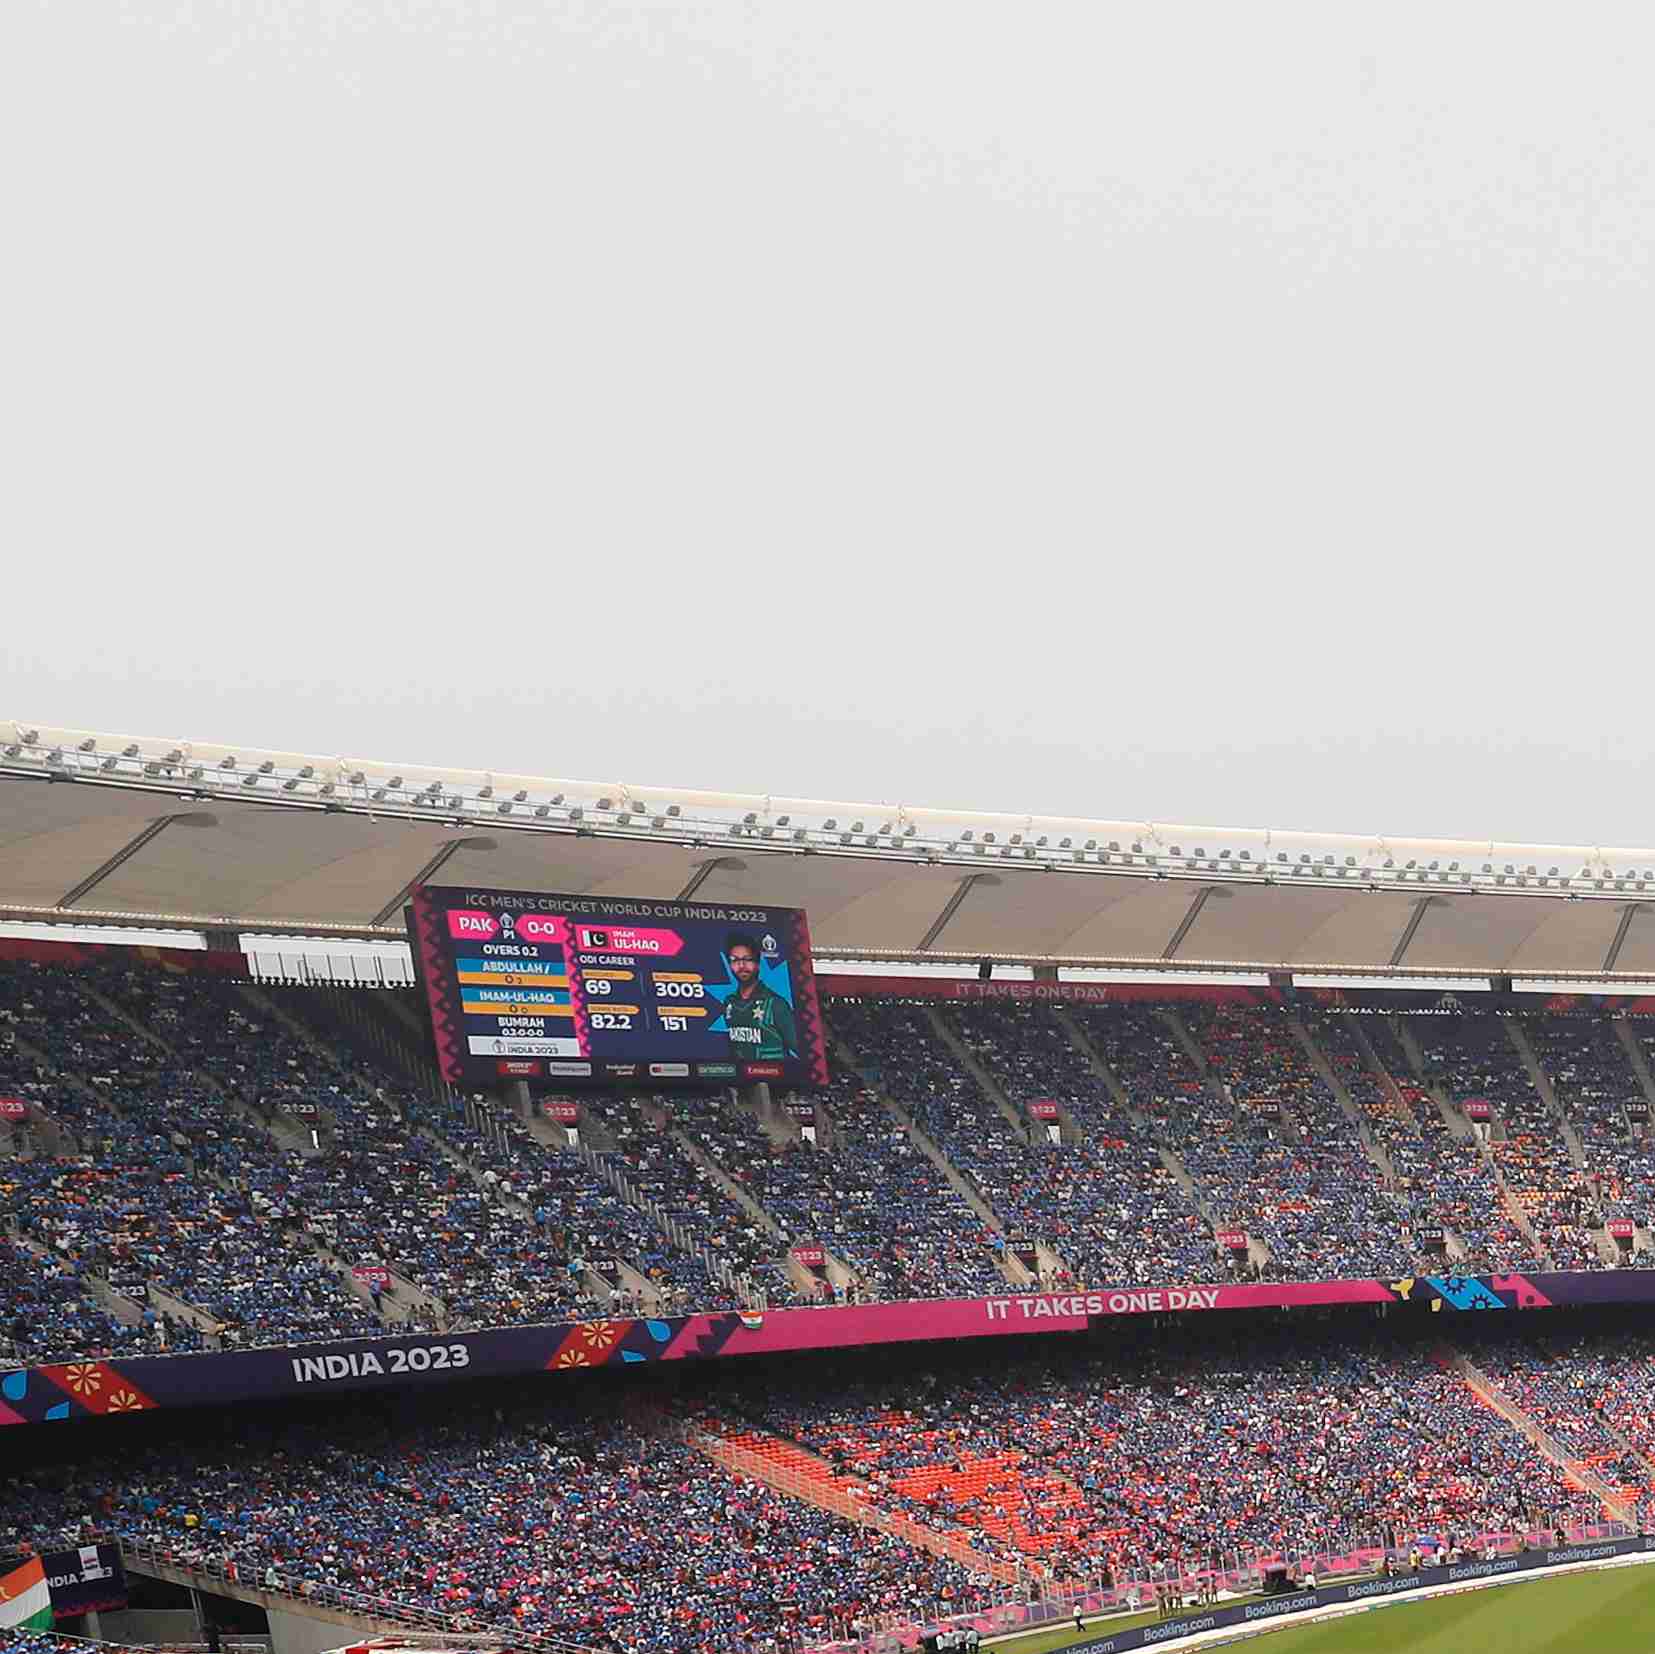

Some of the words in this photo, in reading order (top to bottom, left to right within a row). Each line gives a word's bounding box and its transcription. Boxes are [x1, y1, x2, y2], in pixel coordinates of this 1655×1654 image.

[466, 894, 488, 906] ICC
[491, 895, 535, 909] MEN'S
[538, 898, 597, 912] CRICKET
[600, 902, 651, 916] WORLD
[654, 906, 681, 917] CUP
[684, 908, 726, 921] INDIA
[727, 910, 767, 922] 2023
[459, 917, 494, 932] PAK
[483, 944, 519, 956] OVERS
[521, 946, 538, 957] 0.2
[482, 961, 542, 974] ABDULLAH
[579, 955, 597, 964] ODI
[599, 955, 636, 966] CAREER
[585, 980, 612, 995] 69
[655, 982, 705, 998] 3003
[976, 983, 1031, 998] TAKES
[480, 991, 555, 1003] IMAM-UL-HAQ
[498, 1016, 545, 1028] BUMRAH
[590, 1014, 632, 1030] 82.2
[659, 1016, 688, 1031] 151
[985, 1300, 1010, 1320] IT
[1017, 1296, 1104, 1318] TAKES
[1109, 1294, 1162, 1313] ONE
[1167, 1289, 1220, 1309] DAY
[292, 1351, 385, 1383] INDIA
[387, 1344, 471, 1374] 2023
[1547, 1544, 1617, 1565] Booking.com
[1449, 1558, 1518, 1581] Booking.com
[46, 1572, 80, 1589] NDIA
[1348, 1576, 1420, 1600] Booking.com
[1245, 1594, 1317, 1619] Booking.com
[1143, 1614, 1216, 1642] Booking.com
